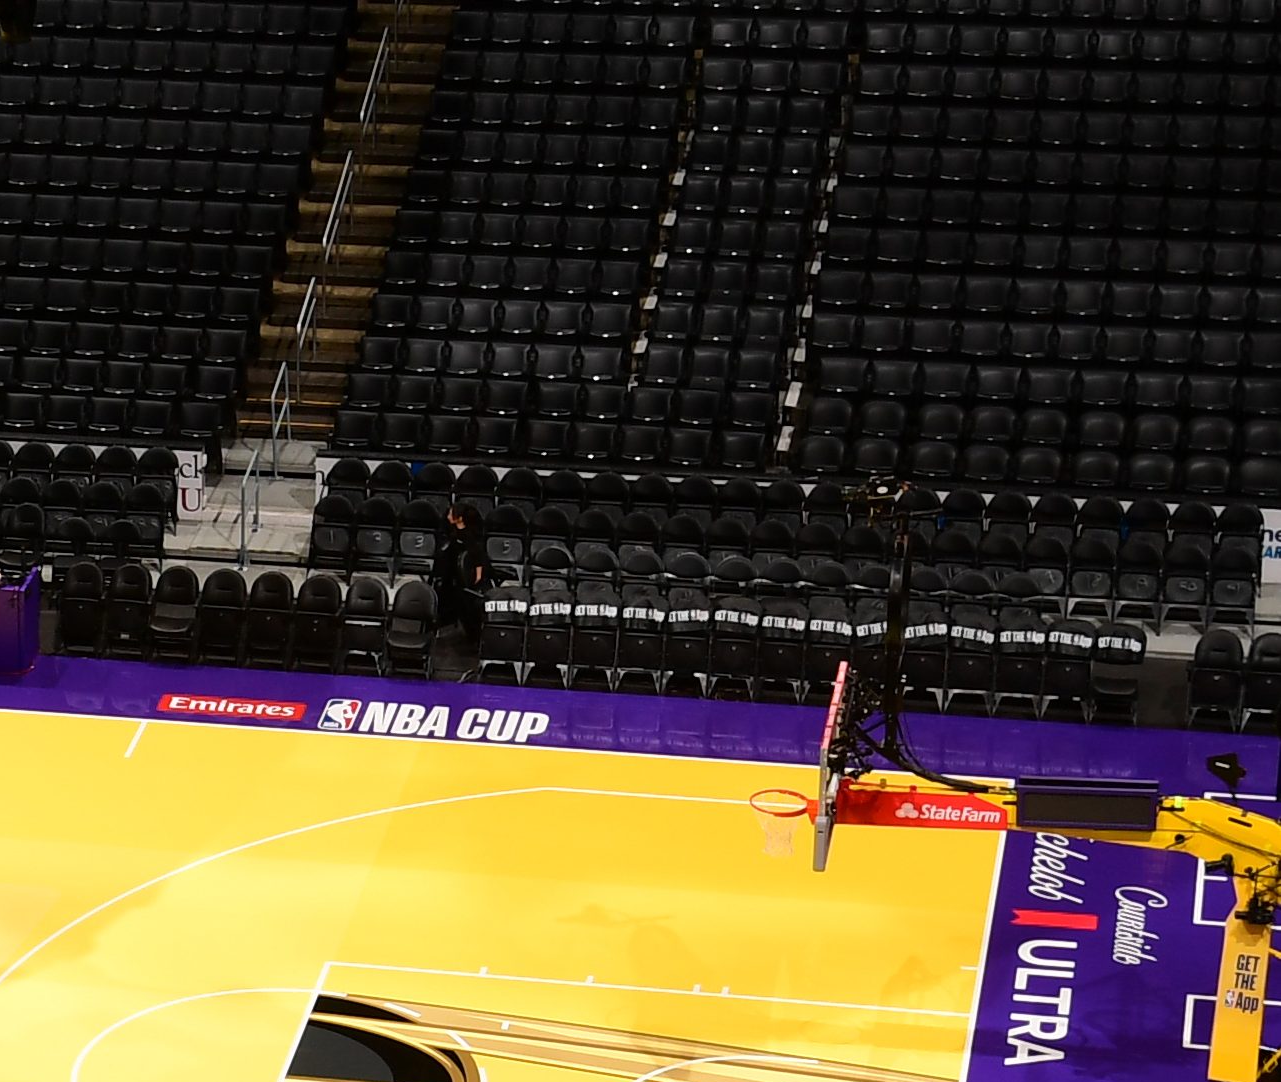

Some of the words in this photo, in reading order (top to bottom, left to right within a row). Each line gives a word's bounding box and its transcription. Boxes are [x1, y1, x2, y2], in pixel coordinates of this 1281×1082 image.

[167, 696, 296, 717] Emirates
[358, 701, 451, 738] NBA
[456, 707, 550, 743] CUP
[1113, 886, 1169, 966] Courtside
[1236, 954, 1261, 973] GET
[1234, 972, 1258, 991] THE
[1004, 939, 1079, 1066] ULTRA
[1234, 991, 1260, 1015] App
